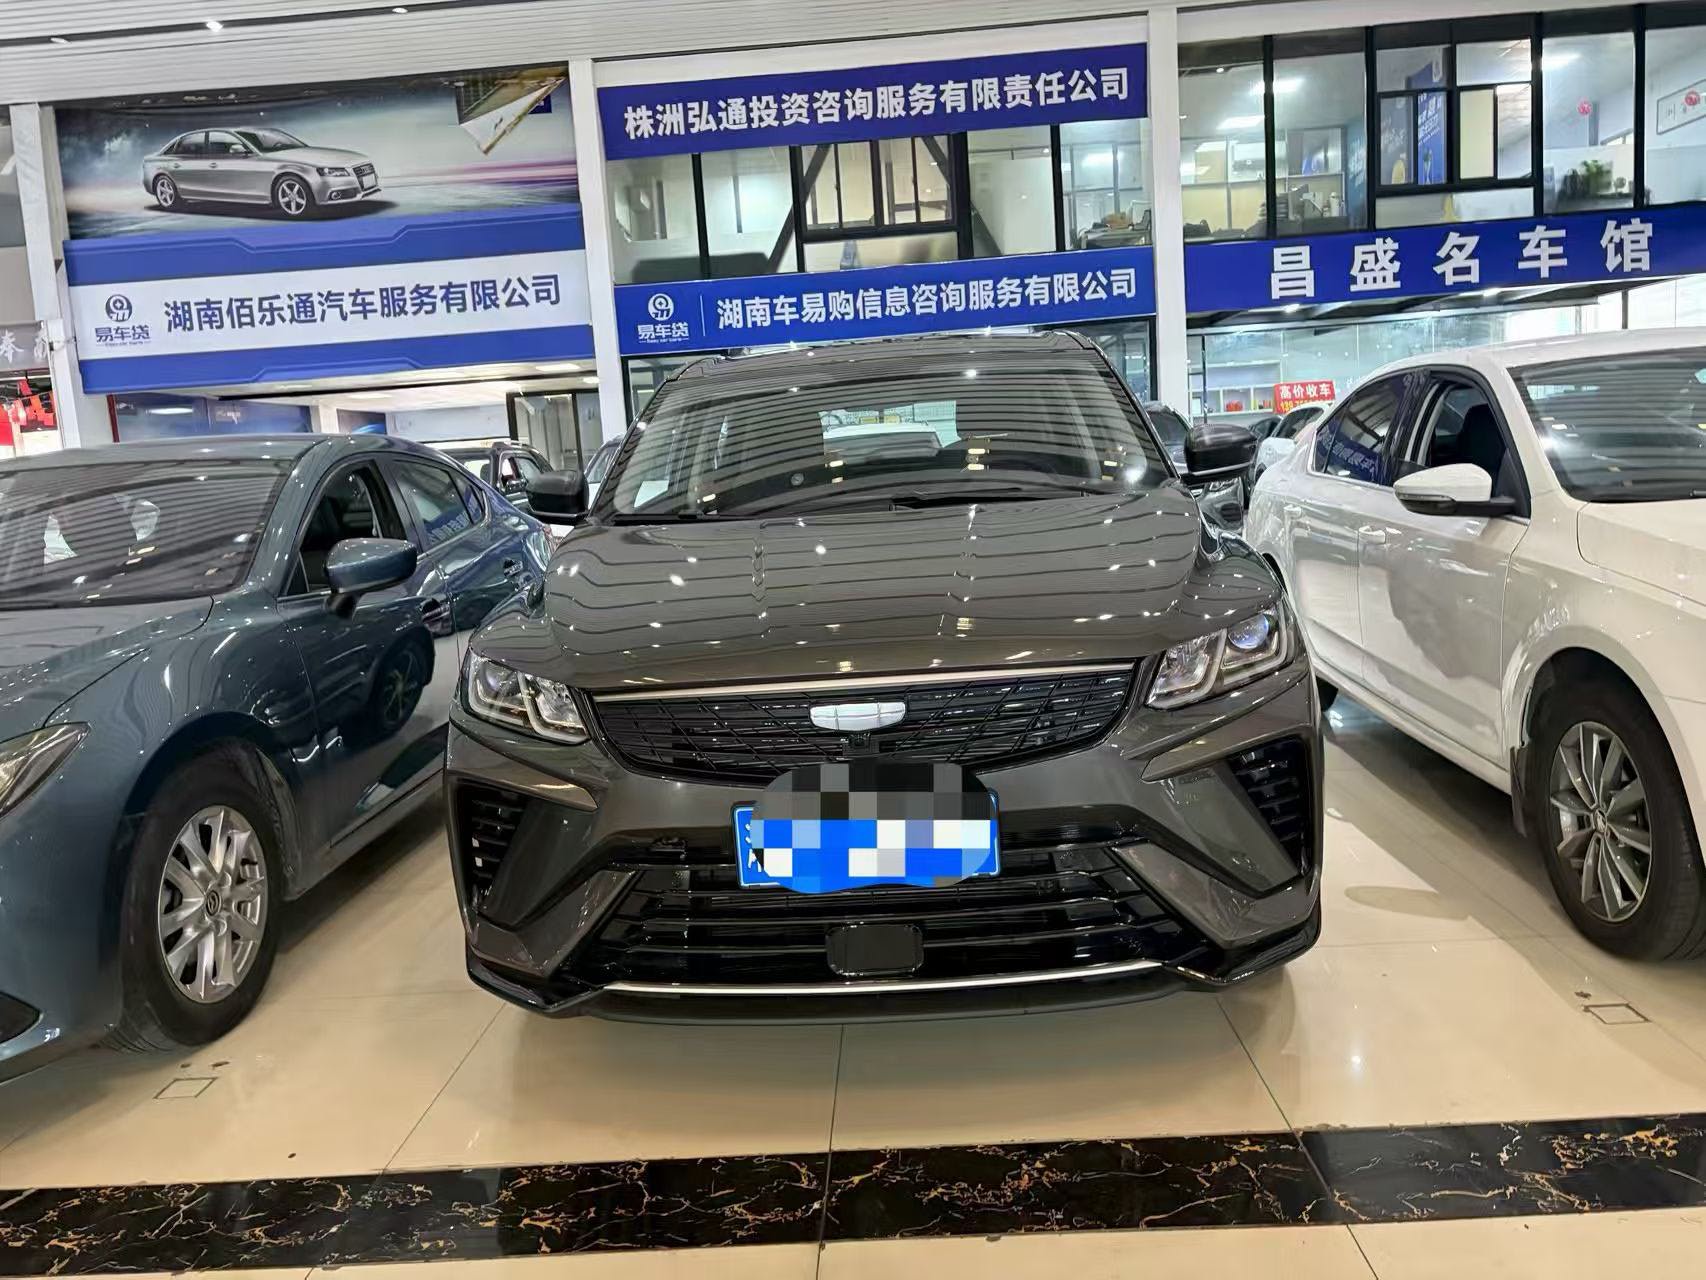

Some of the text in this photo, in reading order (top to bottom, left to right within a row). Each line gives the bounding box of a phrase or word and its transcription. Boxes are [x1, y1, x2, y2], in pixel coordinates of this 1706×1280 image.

[624, 66, 1128, 139] 株洲弘通投资咨询服务有限责任公司
[1271, 217, 1653, 299] 昌盛名车馆
[164, 274, 561, 332] 湖南佰乐通汽车服务有限公司
[717, 268, 1136, 329] 湖南车易购信息咨询服务有限公司
[94, 325, 151, 342] 易车贷
[638, 322, 689, 339] 易车贷
[1280, 383, 1331, 398] 高价收车
